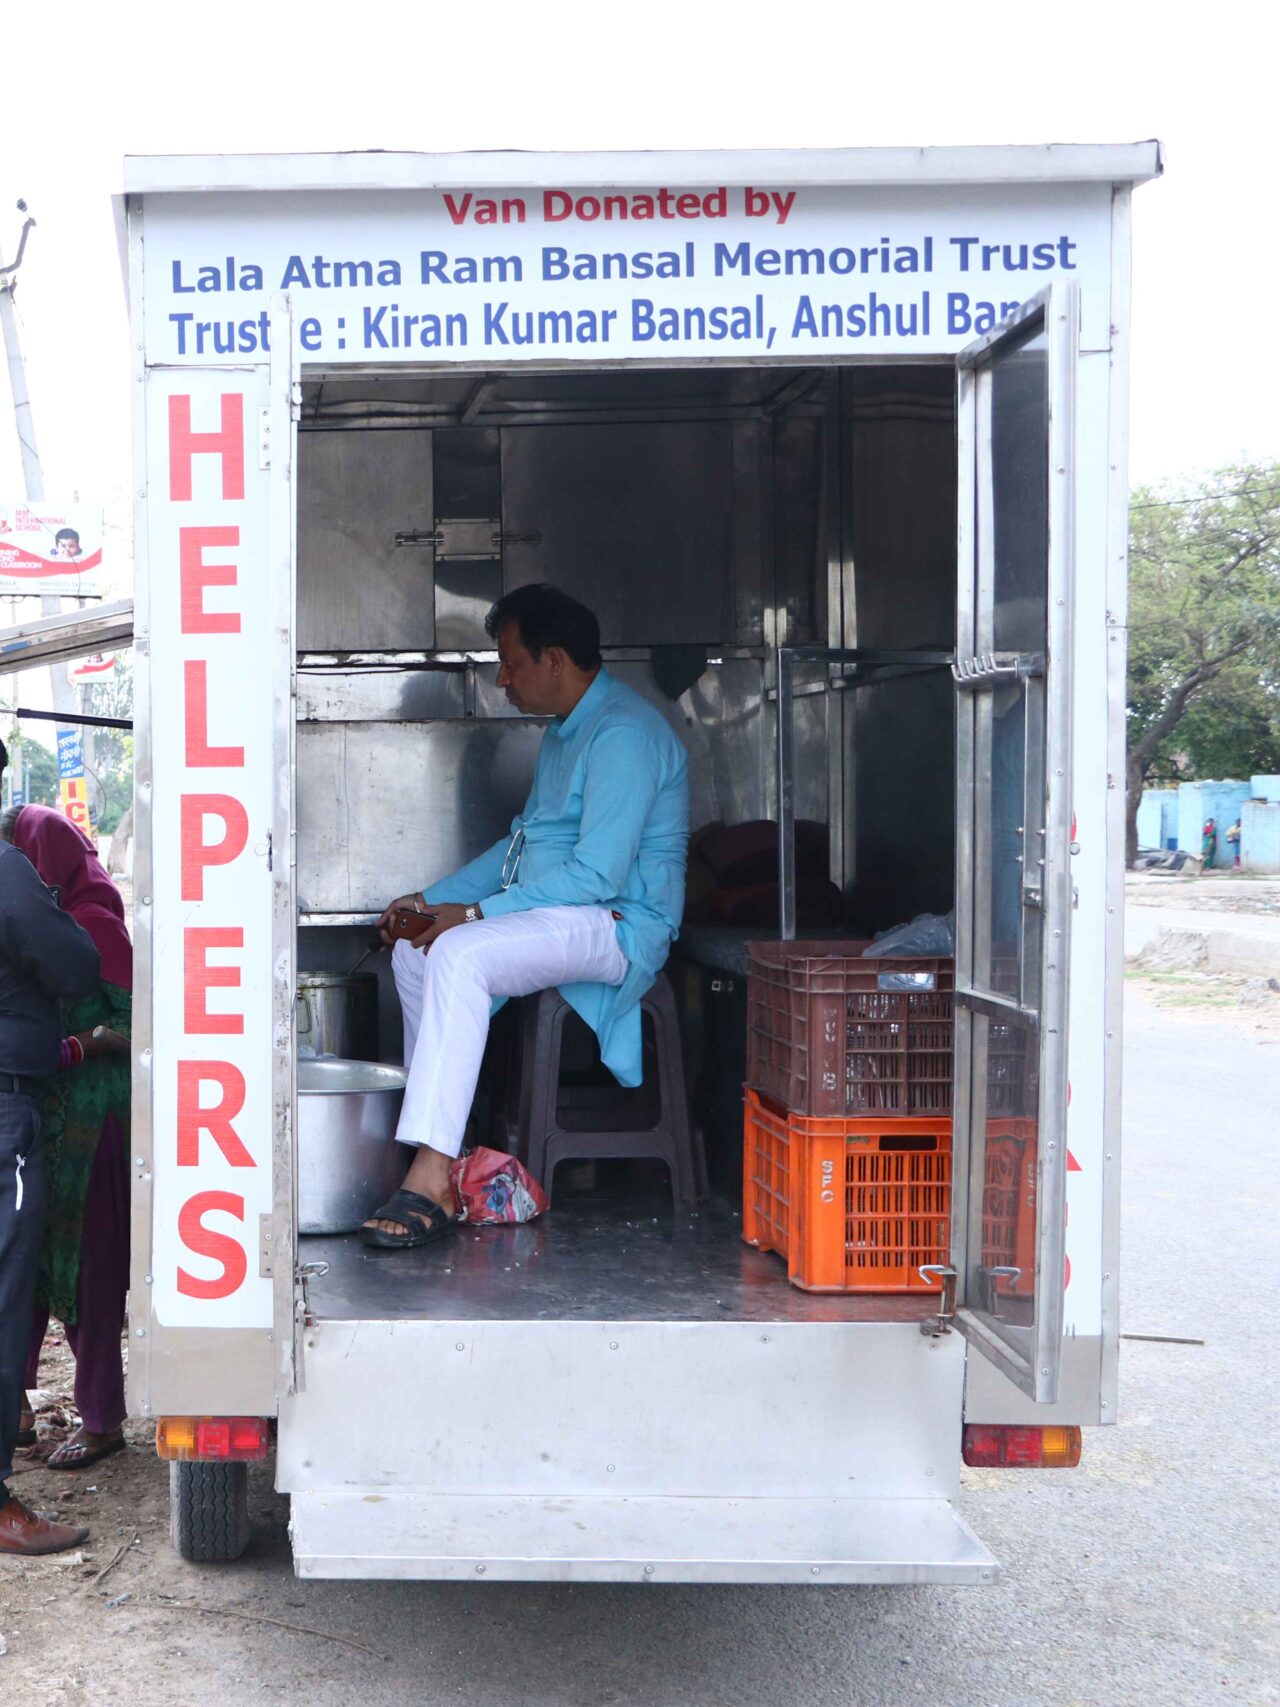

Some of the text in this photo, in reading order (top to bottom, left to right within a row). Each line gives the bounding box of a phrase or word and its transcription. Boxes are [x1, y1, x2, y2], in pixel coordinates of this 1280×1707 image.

[443, 187, 797, 225] Van Donated by
[171, 235, 1078, 294] Lala Atma Ram Bansal Memorial Trust
[168, 310, 322, 356] Truste
[362, 303, 468, 349] Kiran
[483, 303, 618, 346] Kumar
[631, 293, 777, 349] Bansal,
[791, 291, 930, 338] Anshul
[15, 516, 67, 525] INTERNATIONAL
[15, 524, 41, 532] SCHOOL
[168, 393, 257, 1300] HELPERS
